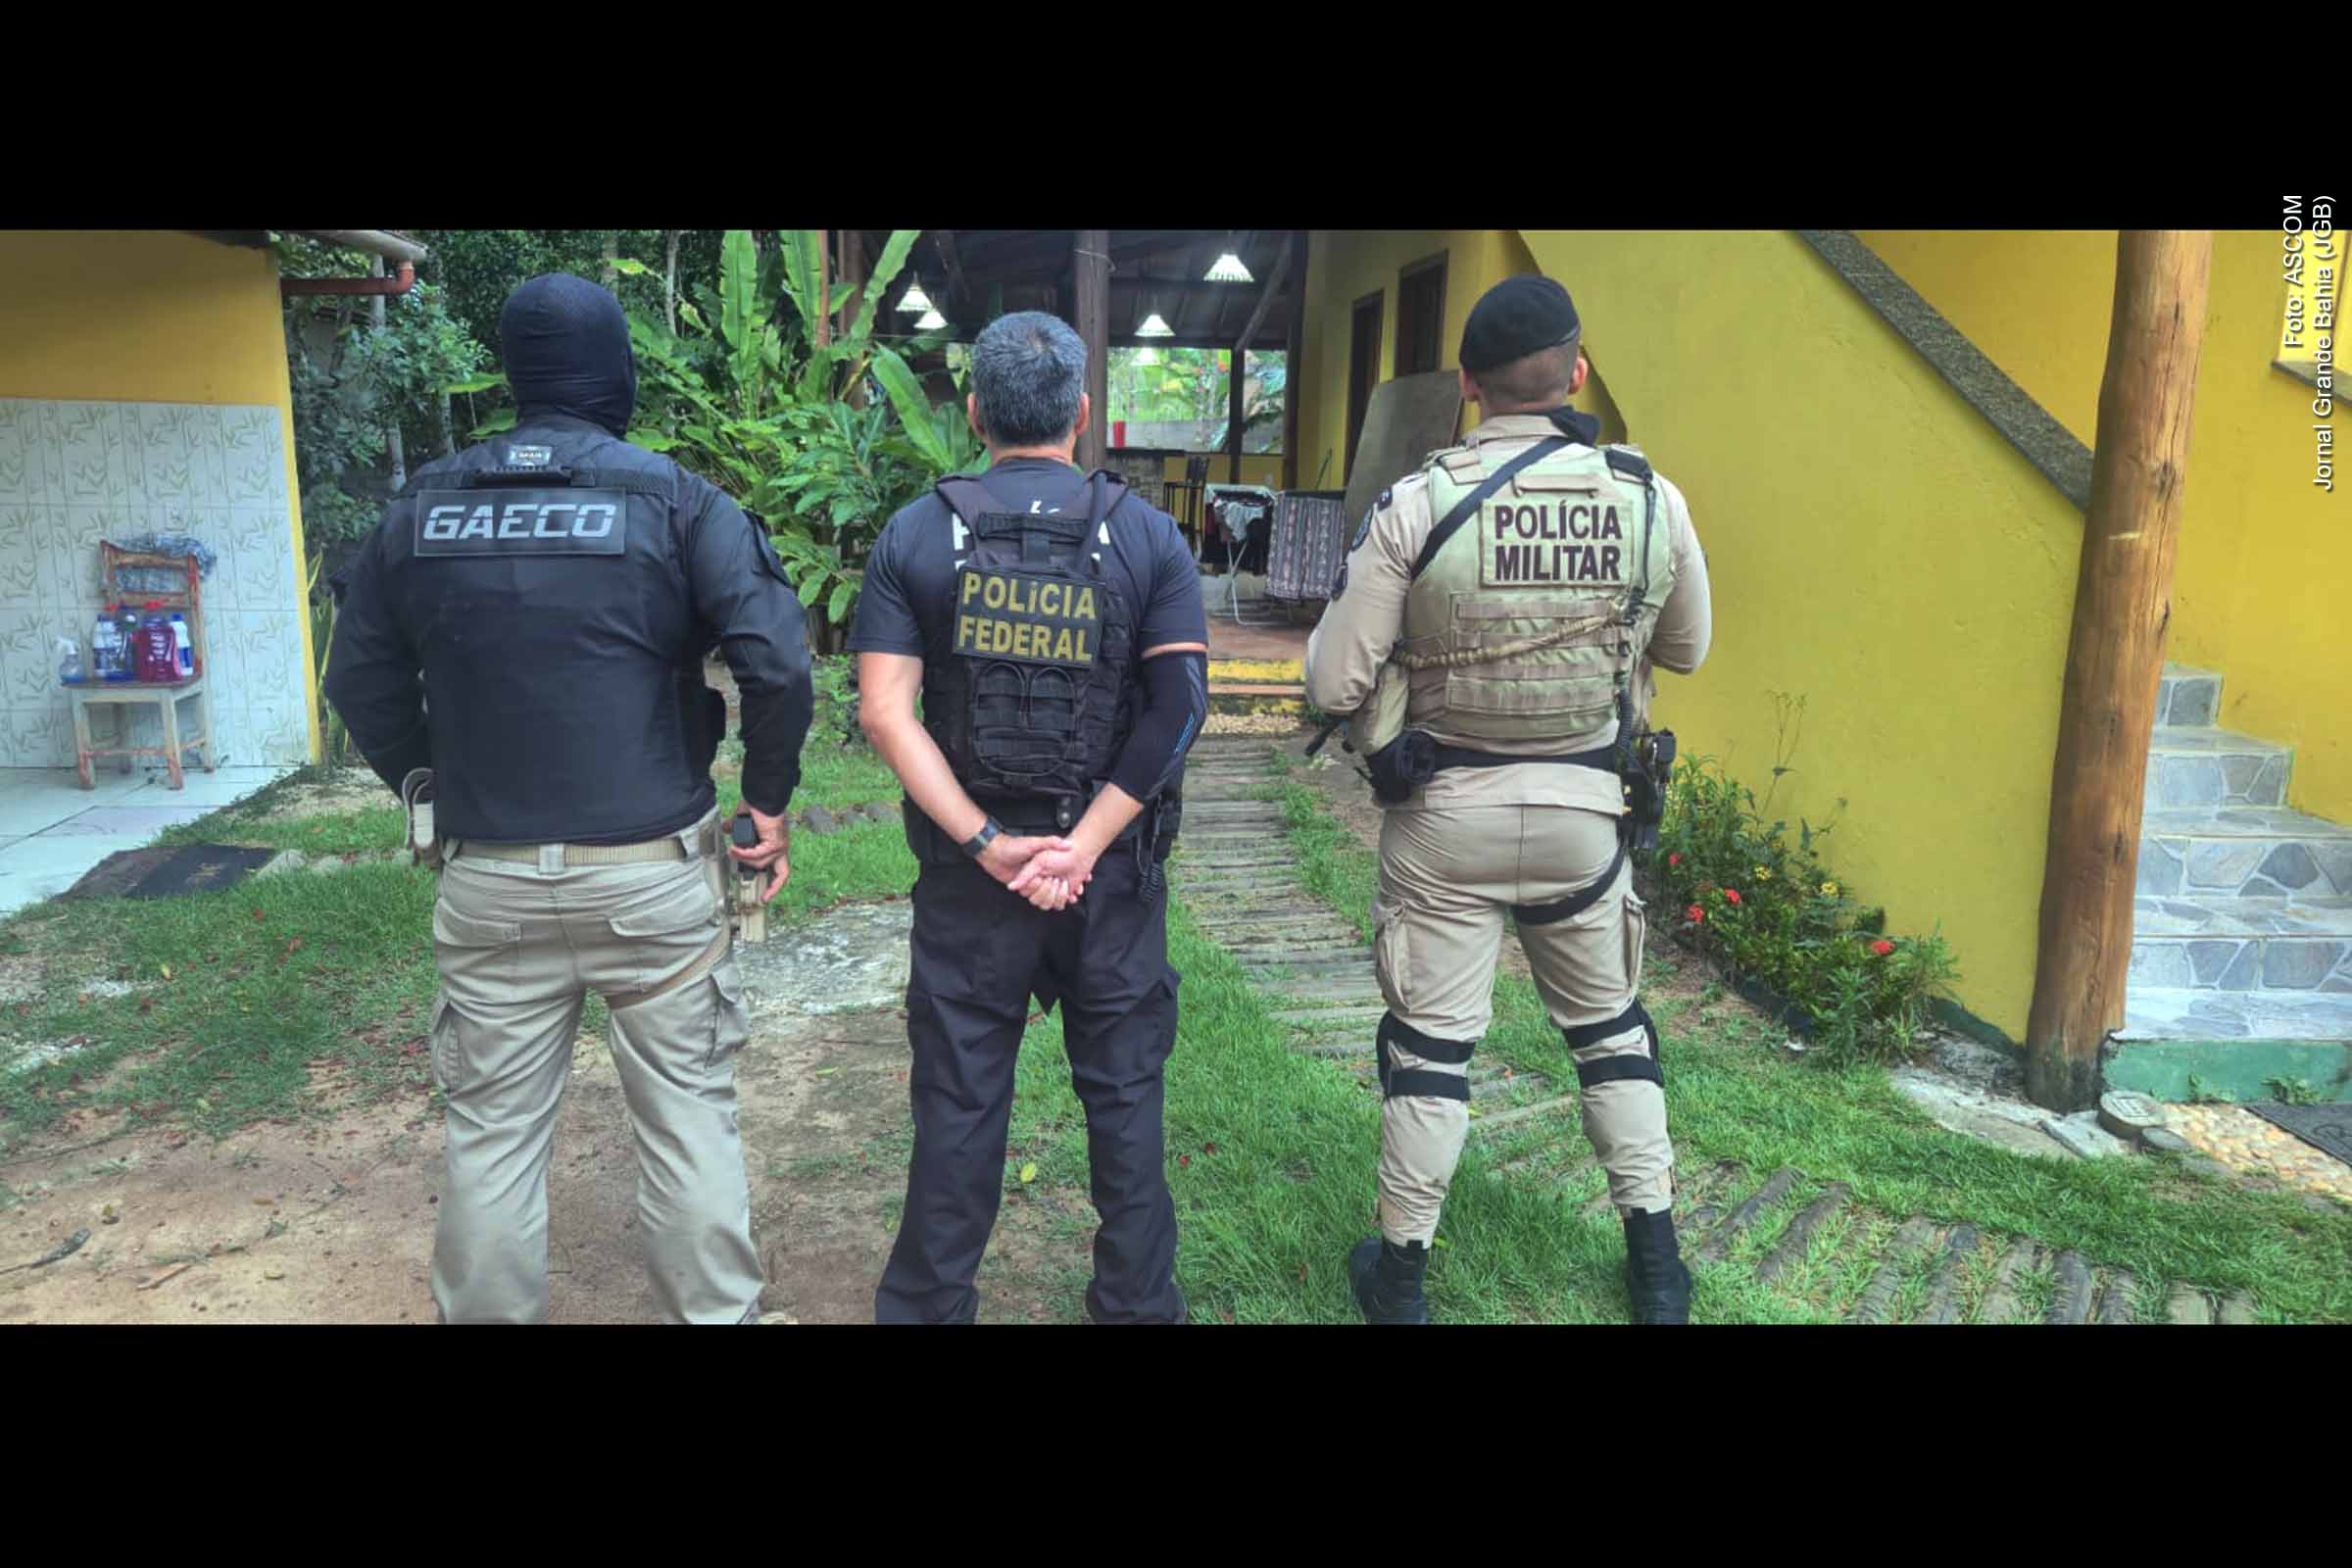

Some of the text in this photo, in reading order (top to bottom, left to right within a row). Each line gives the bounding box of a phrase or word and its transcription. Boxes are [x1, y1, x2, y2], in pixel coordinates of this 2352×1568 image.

[422, 503, 617, 540] GAECO
[1494, 500, 1623, 540] POLÍCIA
[1494, 545, 1621, 581] MILITAR
[956, 613, 1094, 662] FEDERAL
